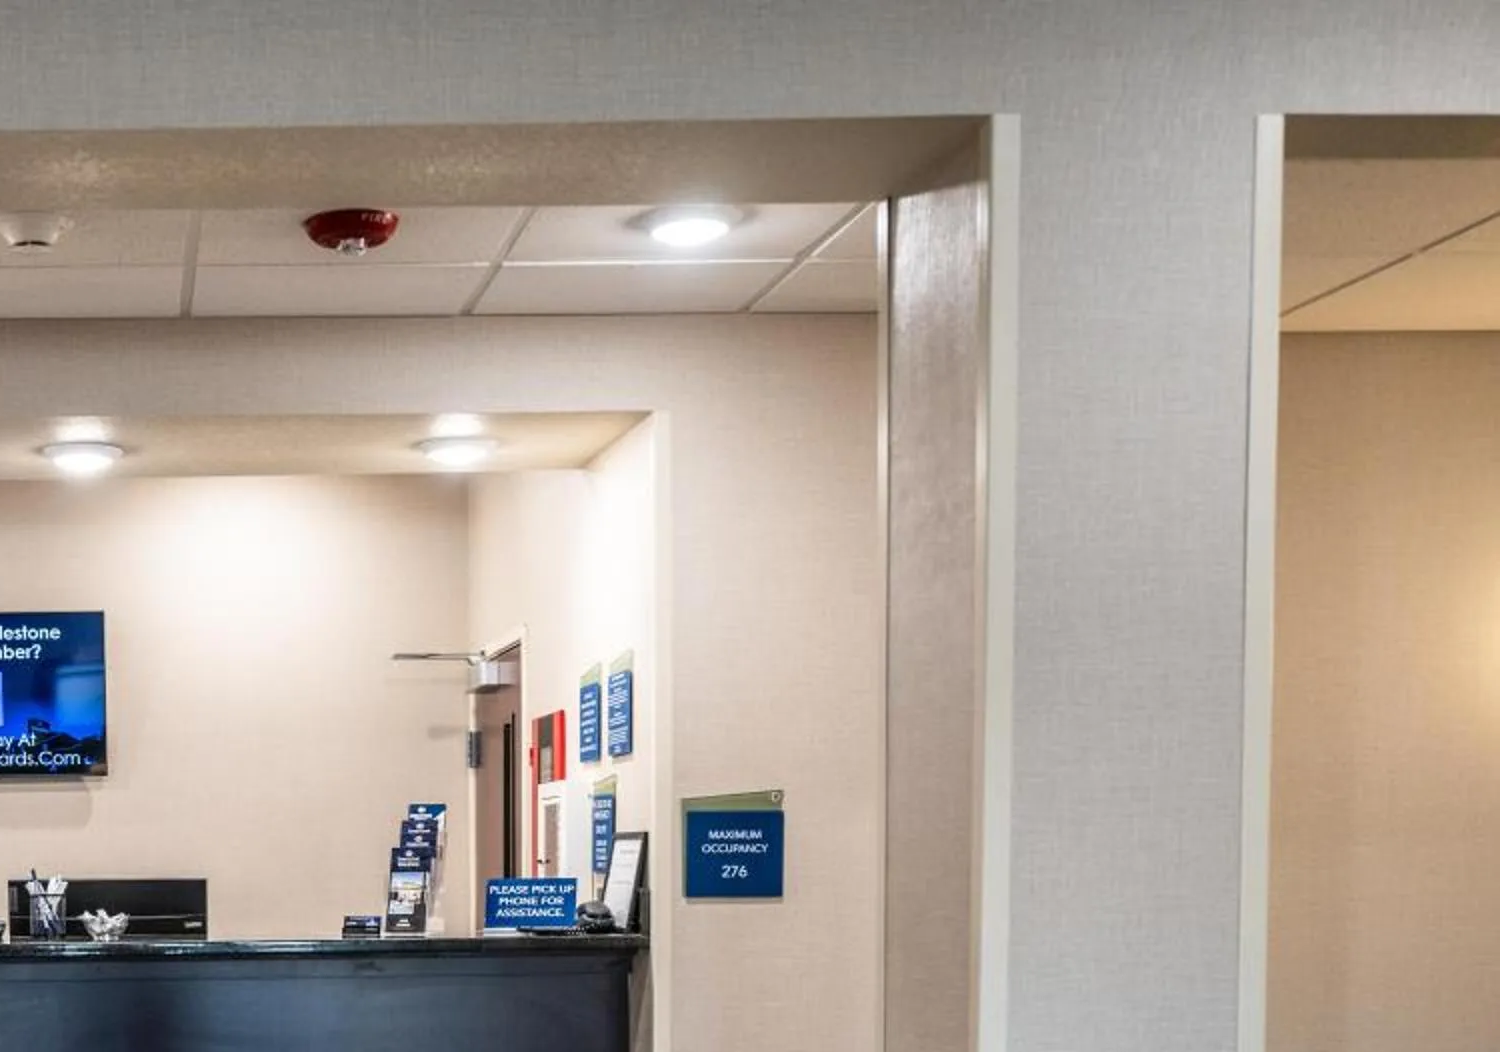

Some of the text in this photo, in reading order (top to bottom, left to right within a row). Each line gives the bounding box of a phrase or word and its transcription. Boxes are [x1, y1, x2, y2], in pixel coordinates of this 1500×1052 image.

[17, 732, 37, 748] At
[707, 829, 763, 840] MAXIMUM
[701, 842, 768, 854] OCCUPANCY
[721, 864, 748, 879] 276
[488, 884, 575, 896] PLEASE PICK UP
[498, 895, 564, 906] PHONE FOR
[495, 907, 565, 918] ASSISTANCE.
